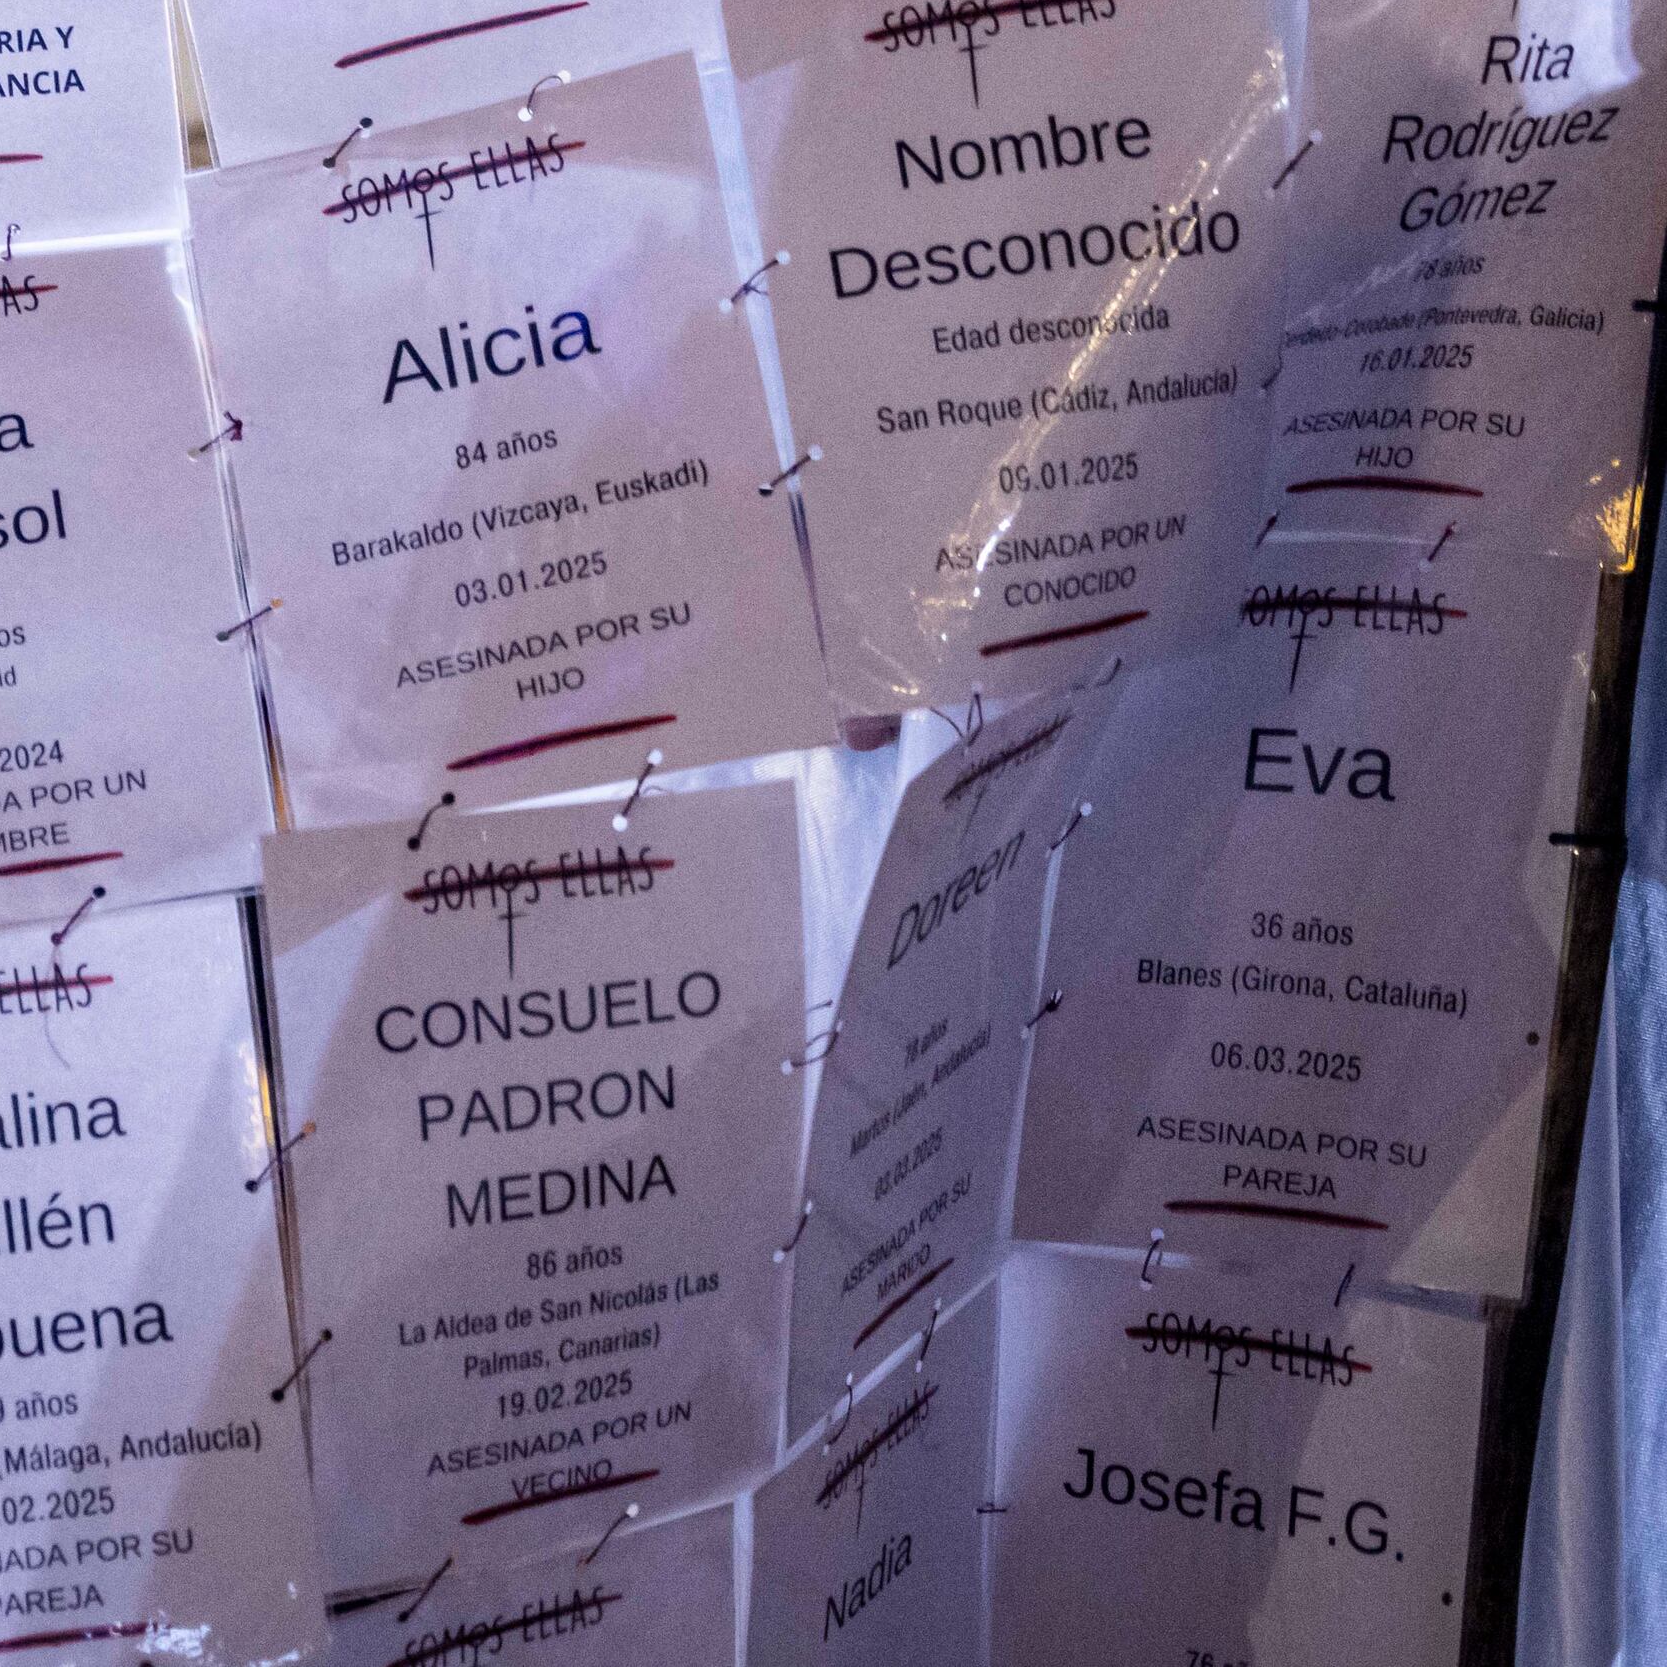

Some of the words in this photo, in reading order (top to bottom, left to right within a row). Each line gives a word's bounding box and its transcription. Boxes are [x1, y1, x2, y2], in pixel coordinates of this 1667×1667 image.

[1481, 33, 1575, 84] Rita
[894, 114, 1152, 190] Nombre
[1382, 102, 1620, 166] Rodríguez
[1398, 177, 1556, 235] Gómez
[828, 200, 1241, 300] Desconocido
[382, 304, 602, 405] Alicia
[1355, 445, 1415, 469] HIJO
[330, 519, 464, 567] Barakaldo
[471, 493, 588, 539] (Vizcaya,
[594, 458, 710, 505] Euskadi)
[453, 550, 609, 608] 03.01.2025
[1002, 565, 1137, 609] CONOCIDO
[1243, 726, 1396, 803] Eva
[885, 829, 1027, 972] Doreen
[373, 970, 722, 1055] CONSUELO
[1136, 957, 1221, 988] Blanes
[1230, 964, 1335, 1000] (Girona,
[1344, 974, 1469, 1019] Cataluña)
[1209, 1040, 1363, 1084] 06.03.2025
[417, 1065, 676, 1142] PADRON
[445, 1153, 677, 1229] MEDINA
[1223, 1164, 1336, 1198] PAREJA
[498, 1369, 633, 1418] 19.02.2025
[119, 1421, 263, 1460] Andalucía)
[1062, 1446, 1266, 1533] Josefa
[1288, 1485, 1404, 1563] F.G.
[822, 1533, 914, 1641] Nadia
